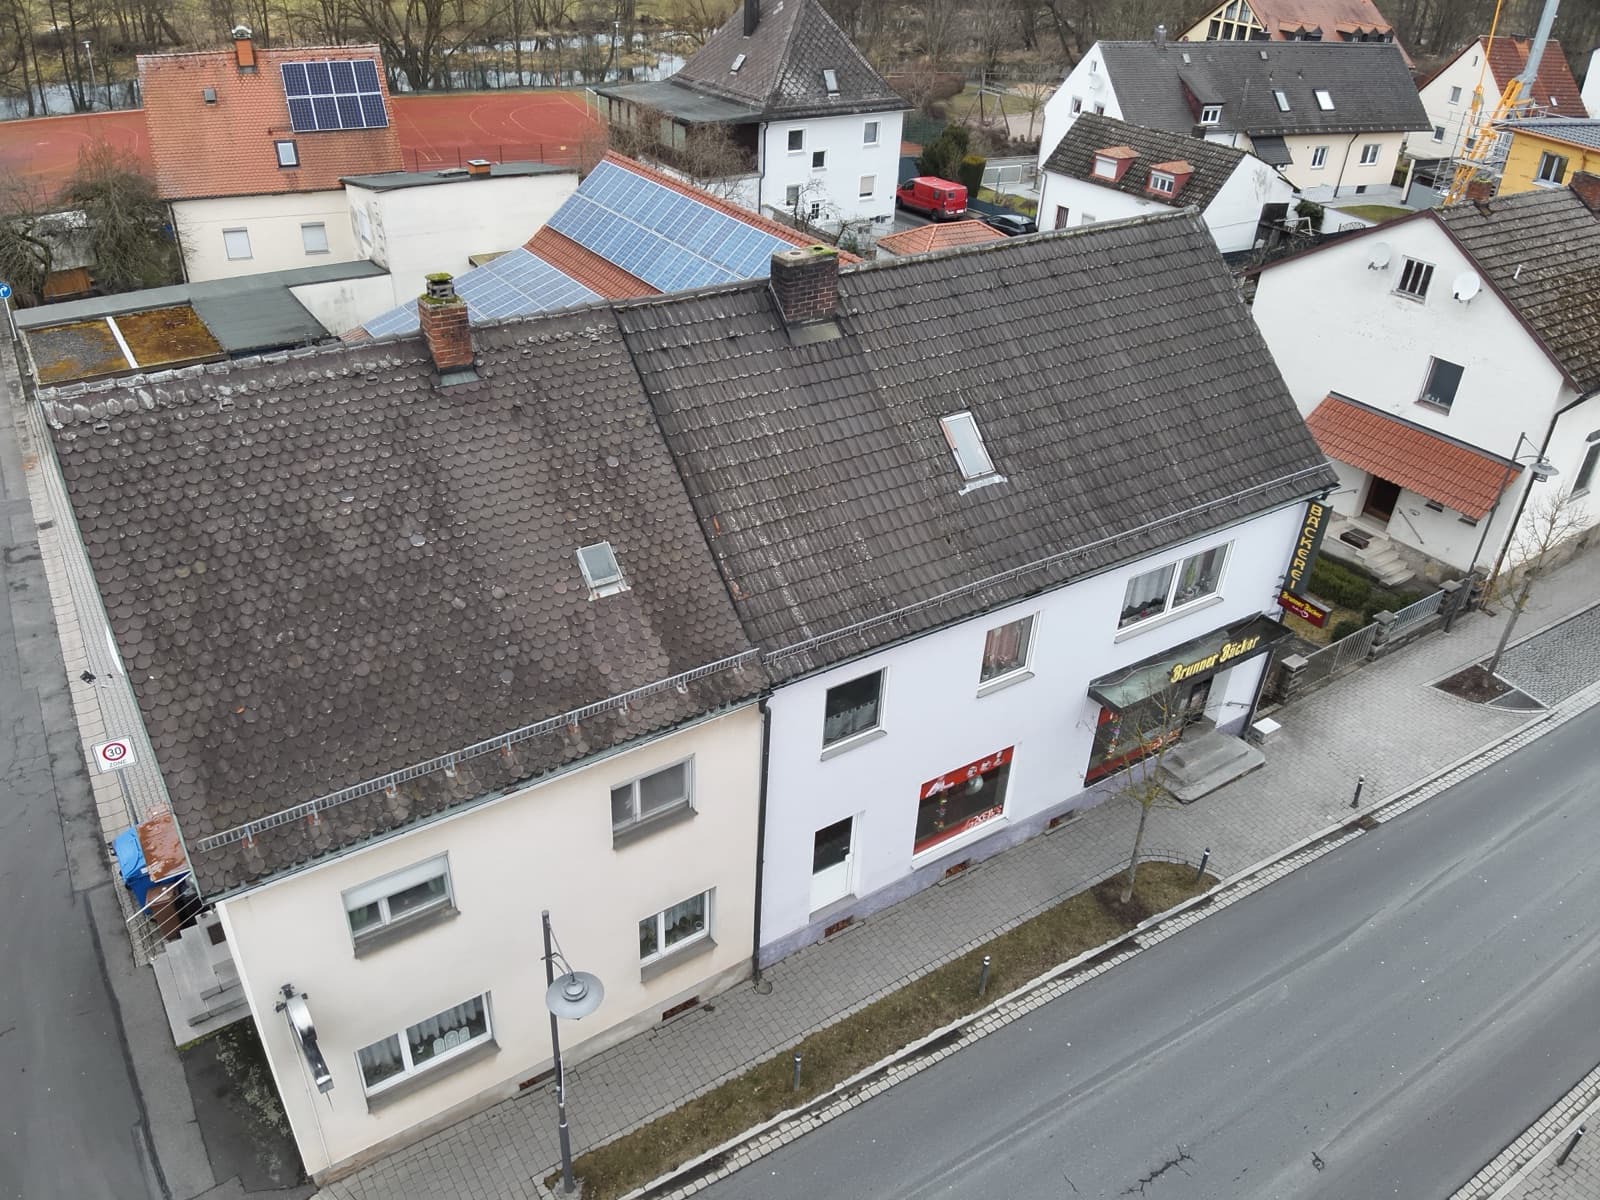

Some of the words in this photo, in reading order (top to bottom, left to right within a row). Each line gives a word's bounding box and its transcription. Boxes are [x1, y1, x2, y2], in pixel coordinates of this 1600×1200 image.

[1290, 504, 1323, 589] BÄCKEREI
[1170, 653, 1219, 683] Brunner
[1219, 635, 1261, 663] Bäcker
[107, 746, 122, 757] 30
[109, 759, 127, 768] ZONE
